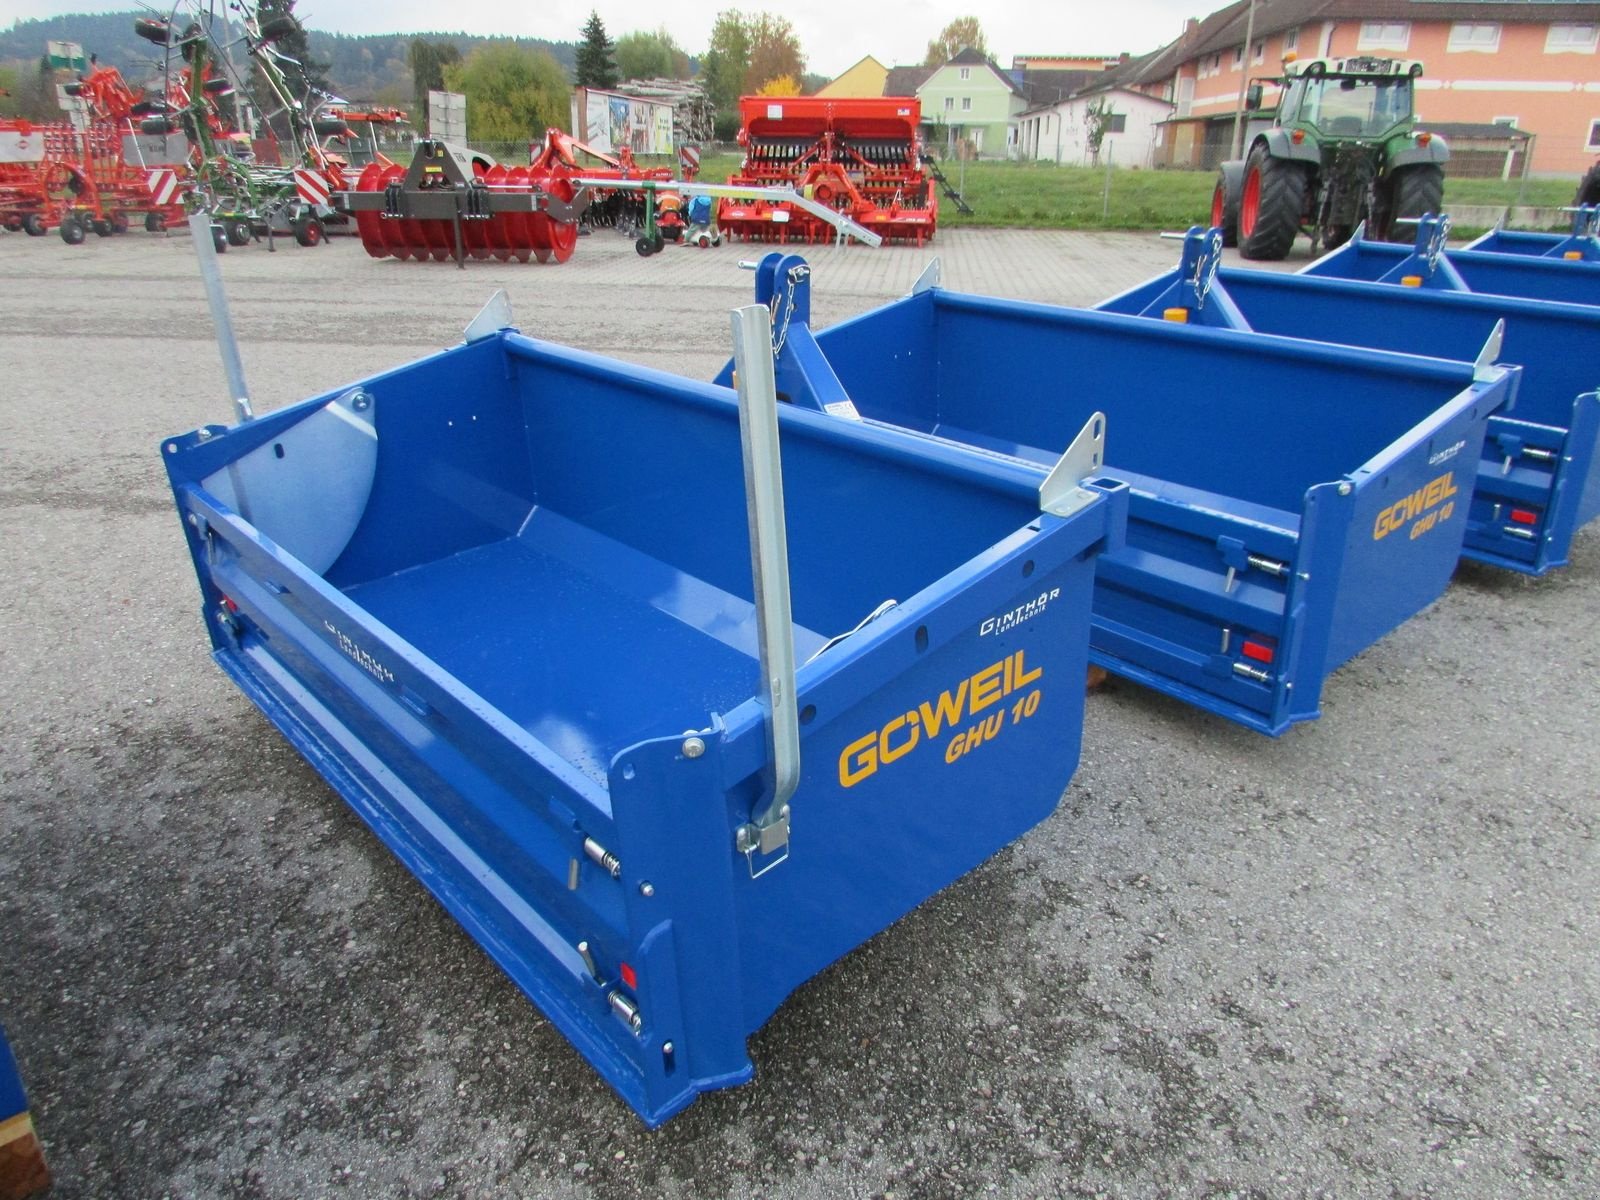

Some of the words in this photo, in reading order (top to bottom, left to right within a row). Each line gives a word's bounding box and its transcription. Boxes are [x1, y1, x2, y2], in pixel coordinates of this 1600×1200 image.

[1439, 501, 1454, 522] 10
[979, 587, 1061, 637] GINTHÖR
[944, 708, 1006, 765] GHU
[1011, 689, 1042, 725] 10
